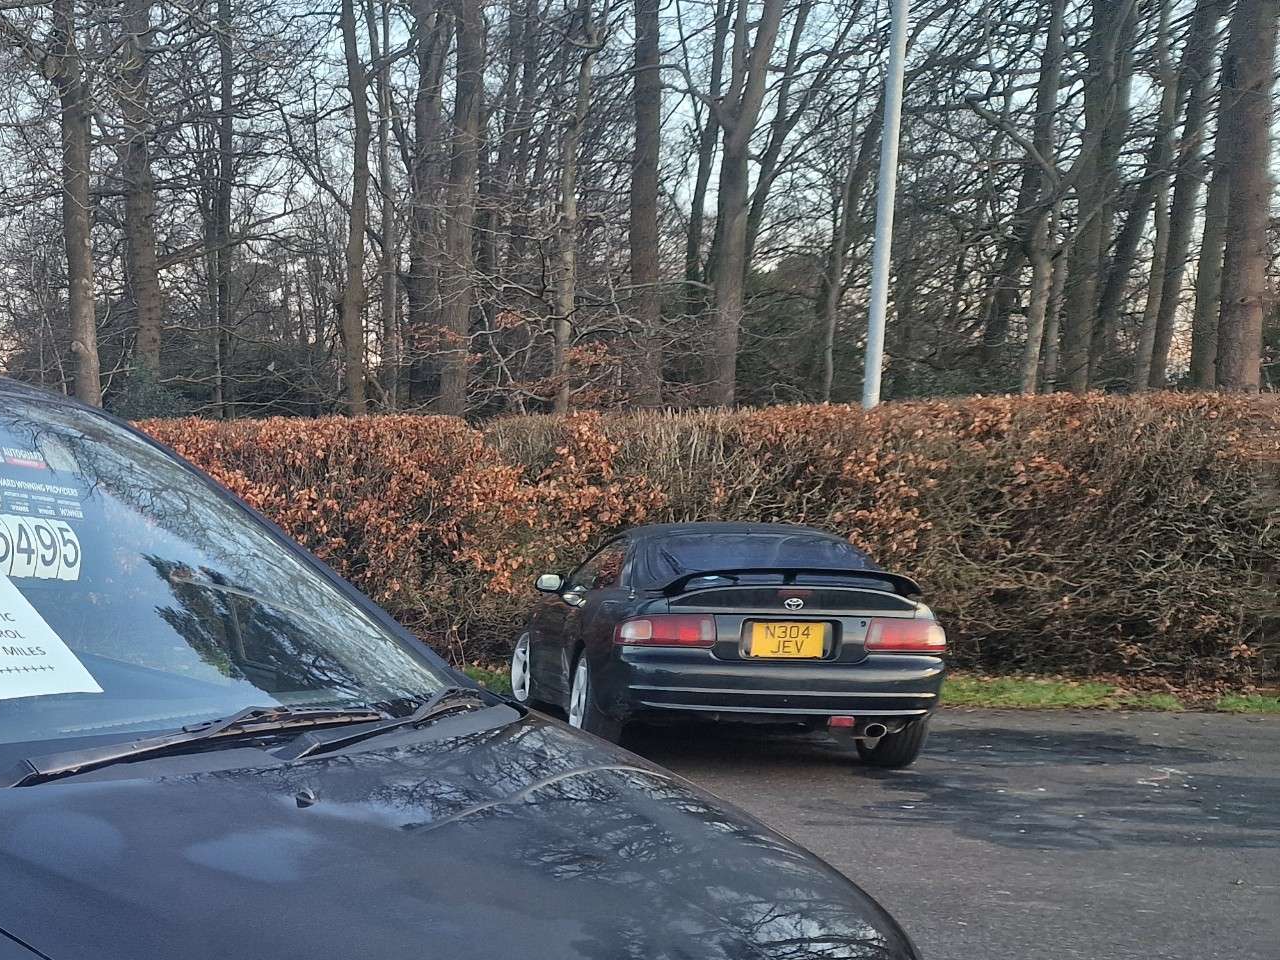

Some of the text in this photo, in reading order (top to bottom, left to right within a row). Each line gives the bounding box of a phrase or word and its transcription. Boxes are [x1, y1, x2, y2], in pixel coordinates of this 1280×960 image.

[766, 625, 811, 639] N304
[2, 646, 47, 658] MILES
[770, 640, 805, 654] JEV
